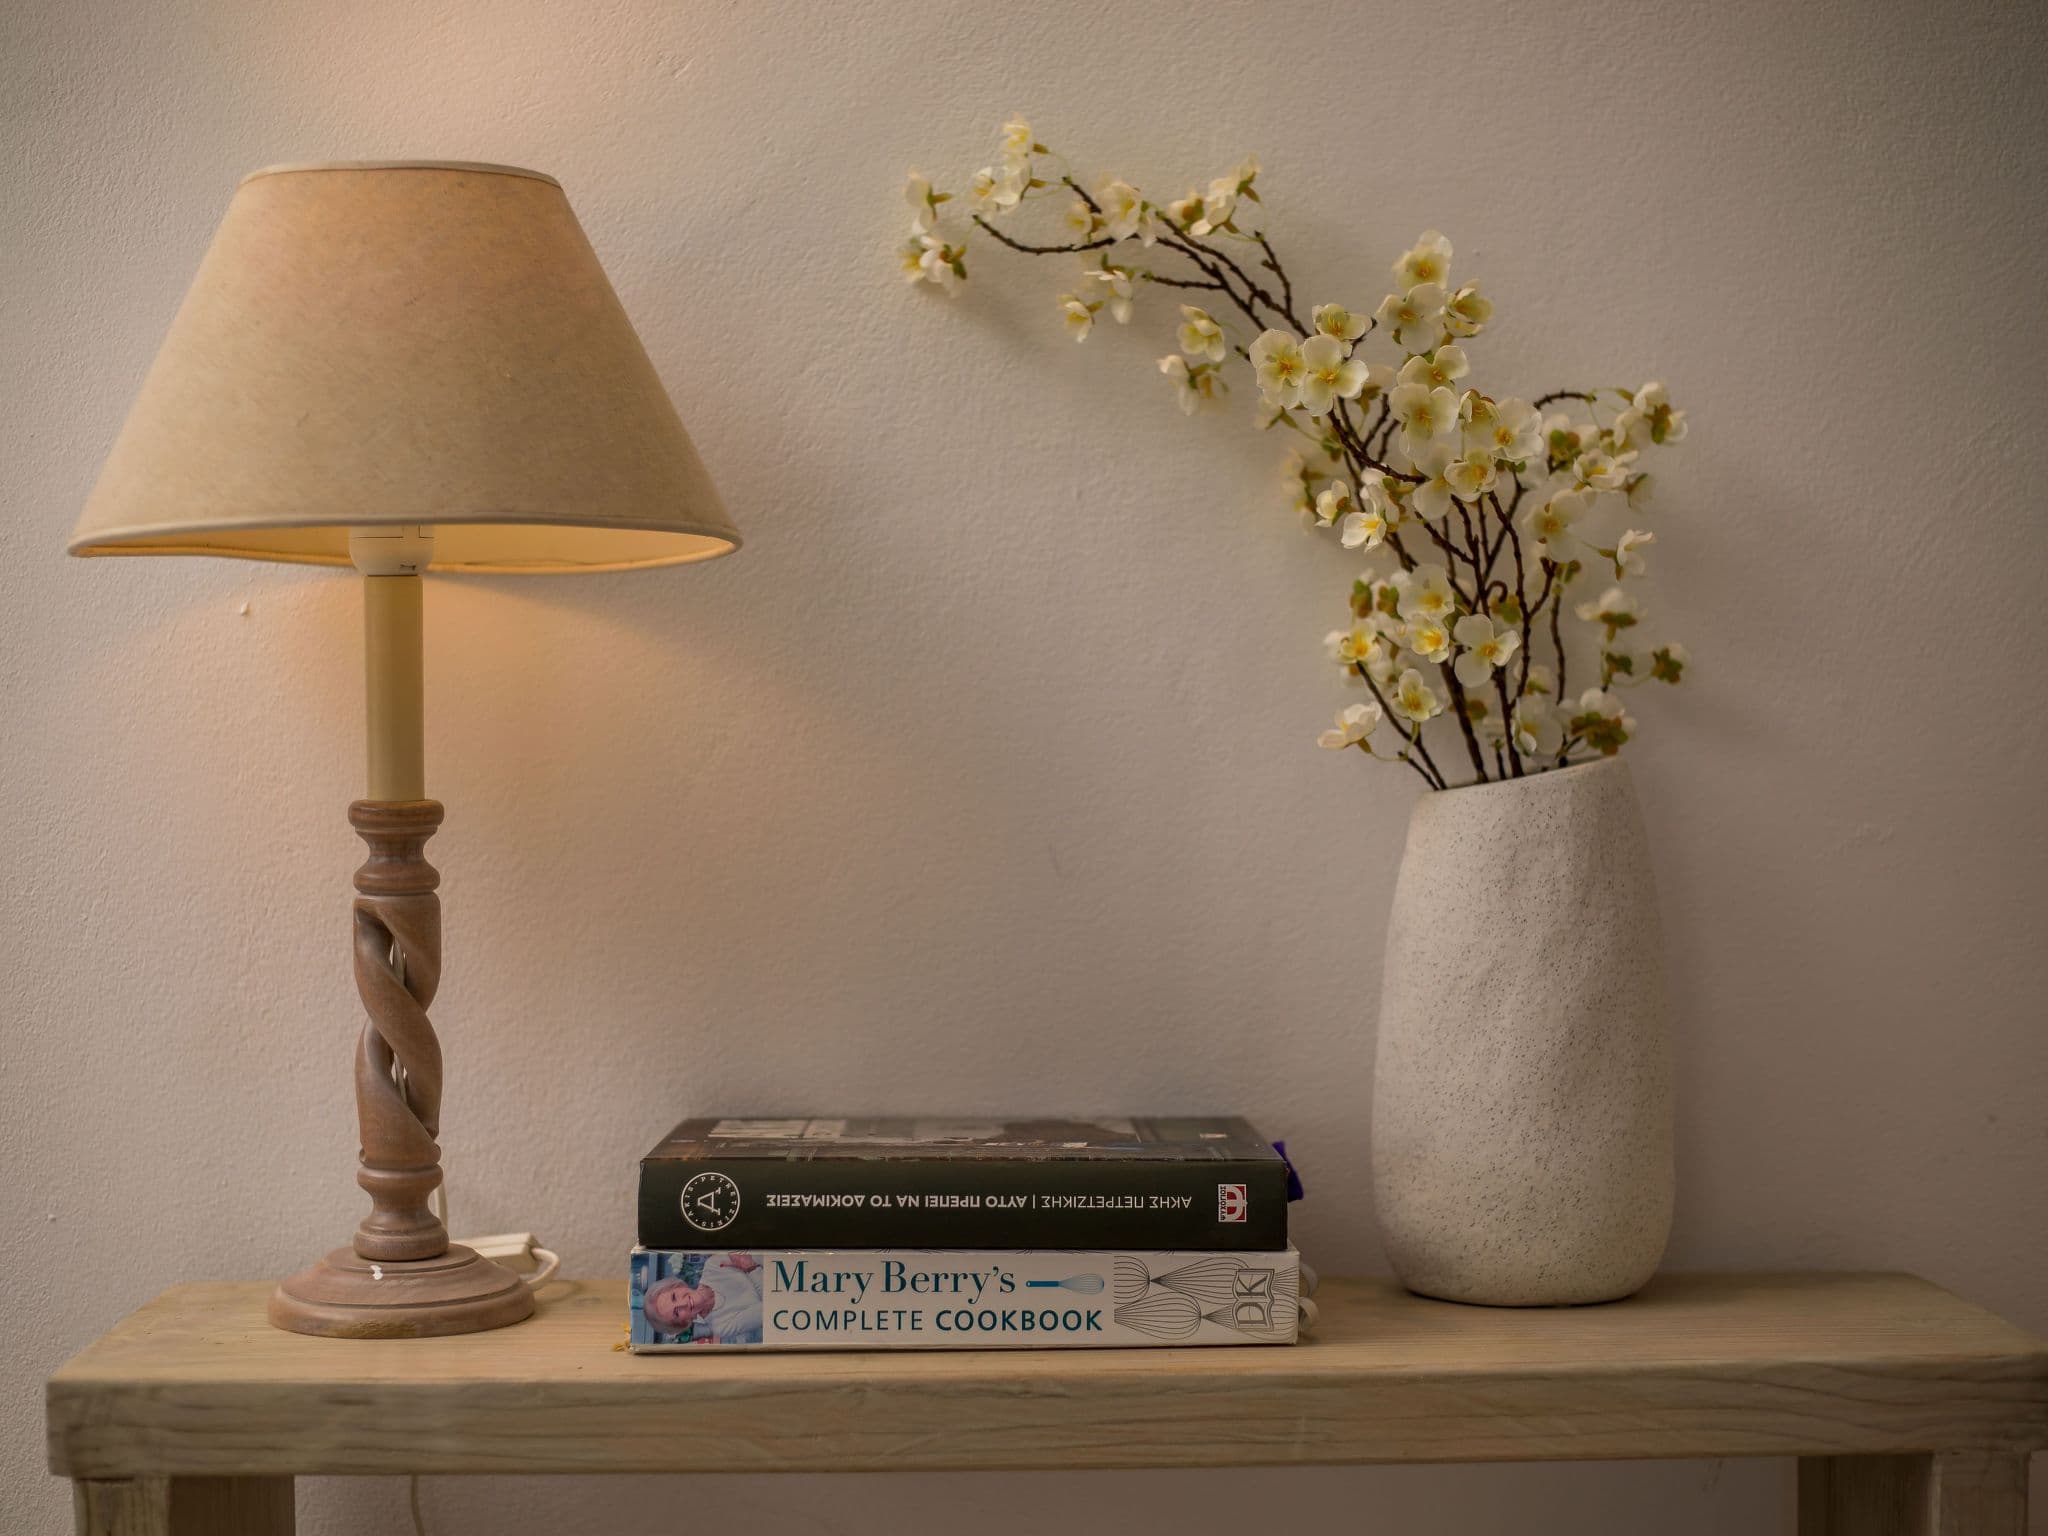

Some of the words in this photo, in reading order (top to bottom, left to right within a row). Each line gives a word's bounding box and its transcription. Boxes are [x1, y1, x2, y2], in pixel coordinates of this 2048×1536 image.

[684, 1186, 694, 1217] AKIS
[766, 1194, 866, 1208] ΔΟΚΙΜΑΣΕΙΣ
[869, 1194, 892, 1208] ΤΟ
[895, 1194, 920, 1208] ΝΑ
[924, 1195, 981, 1208] ΠΡΕΠΕΙ
[985, 1195, 1028, 1208] ΑΥΤΟ
[1040, 1195, 1144, 1209] ΠΕΤΡΕΤΖΙΚΗΣ
[1148, 1195, 1193, 1209] ΑΚΗΣ
[771, 1260, 874, 1305] Mary
[880, 1260, 1016, 1305] Berry’s
[1234, 1272, 1270, 1328] DK
[773, 1309, 923, 1331] COMPLETE
[935, 1309, 1103, 1331] COOKBOOK
